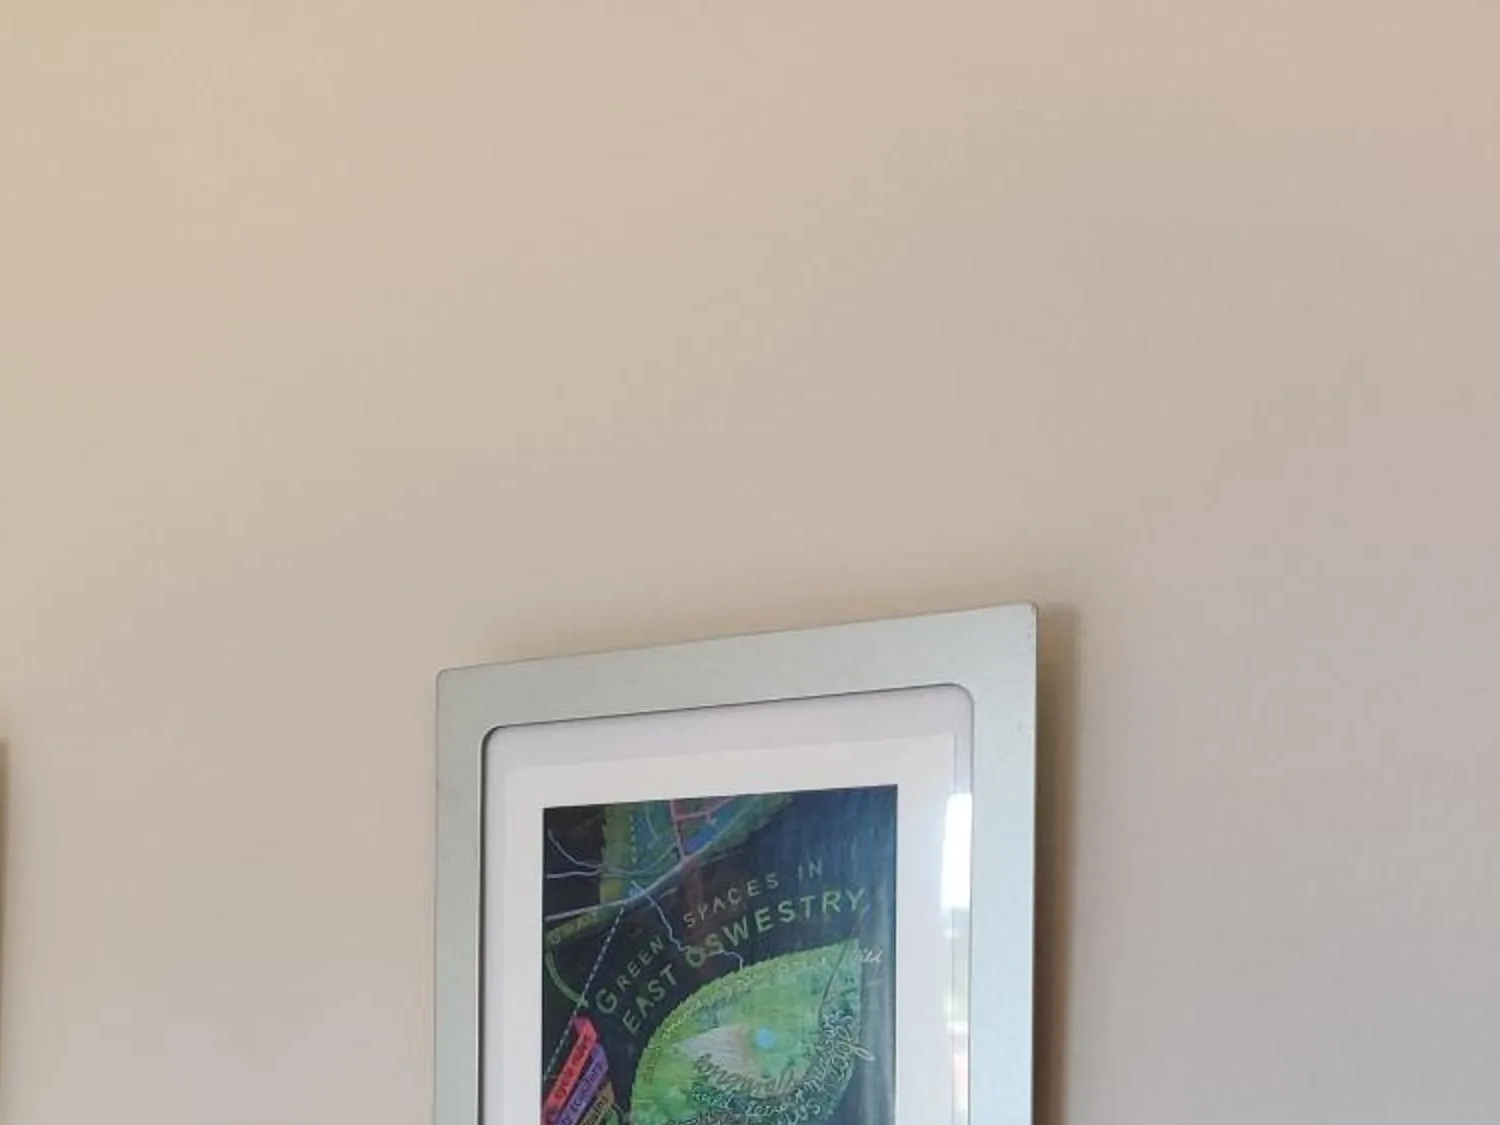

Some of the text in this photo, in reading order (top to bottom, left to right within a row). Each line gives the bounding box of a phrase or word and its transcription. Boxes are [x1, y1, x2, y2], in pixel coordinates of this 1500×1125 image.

[596, 860, 823, 1015] GREEN SPACES IN
[621, 963, 678, 1035] EAST
[685, 888, 865, 967] OSWESTRY
